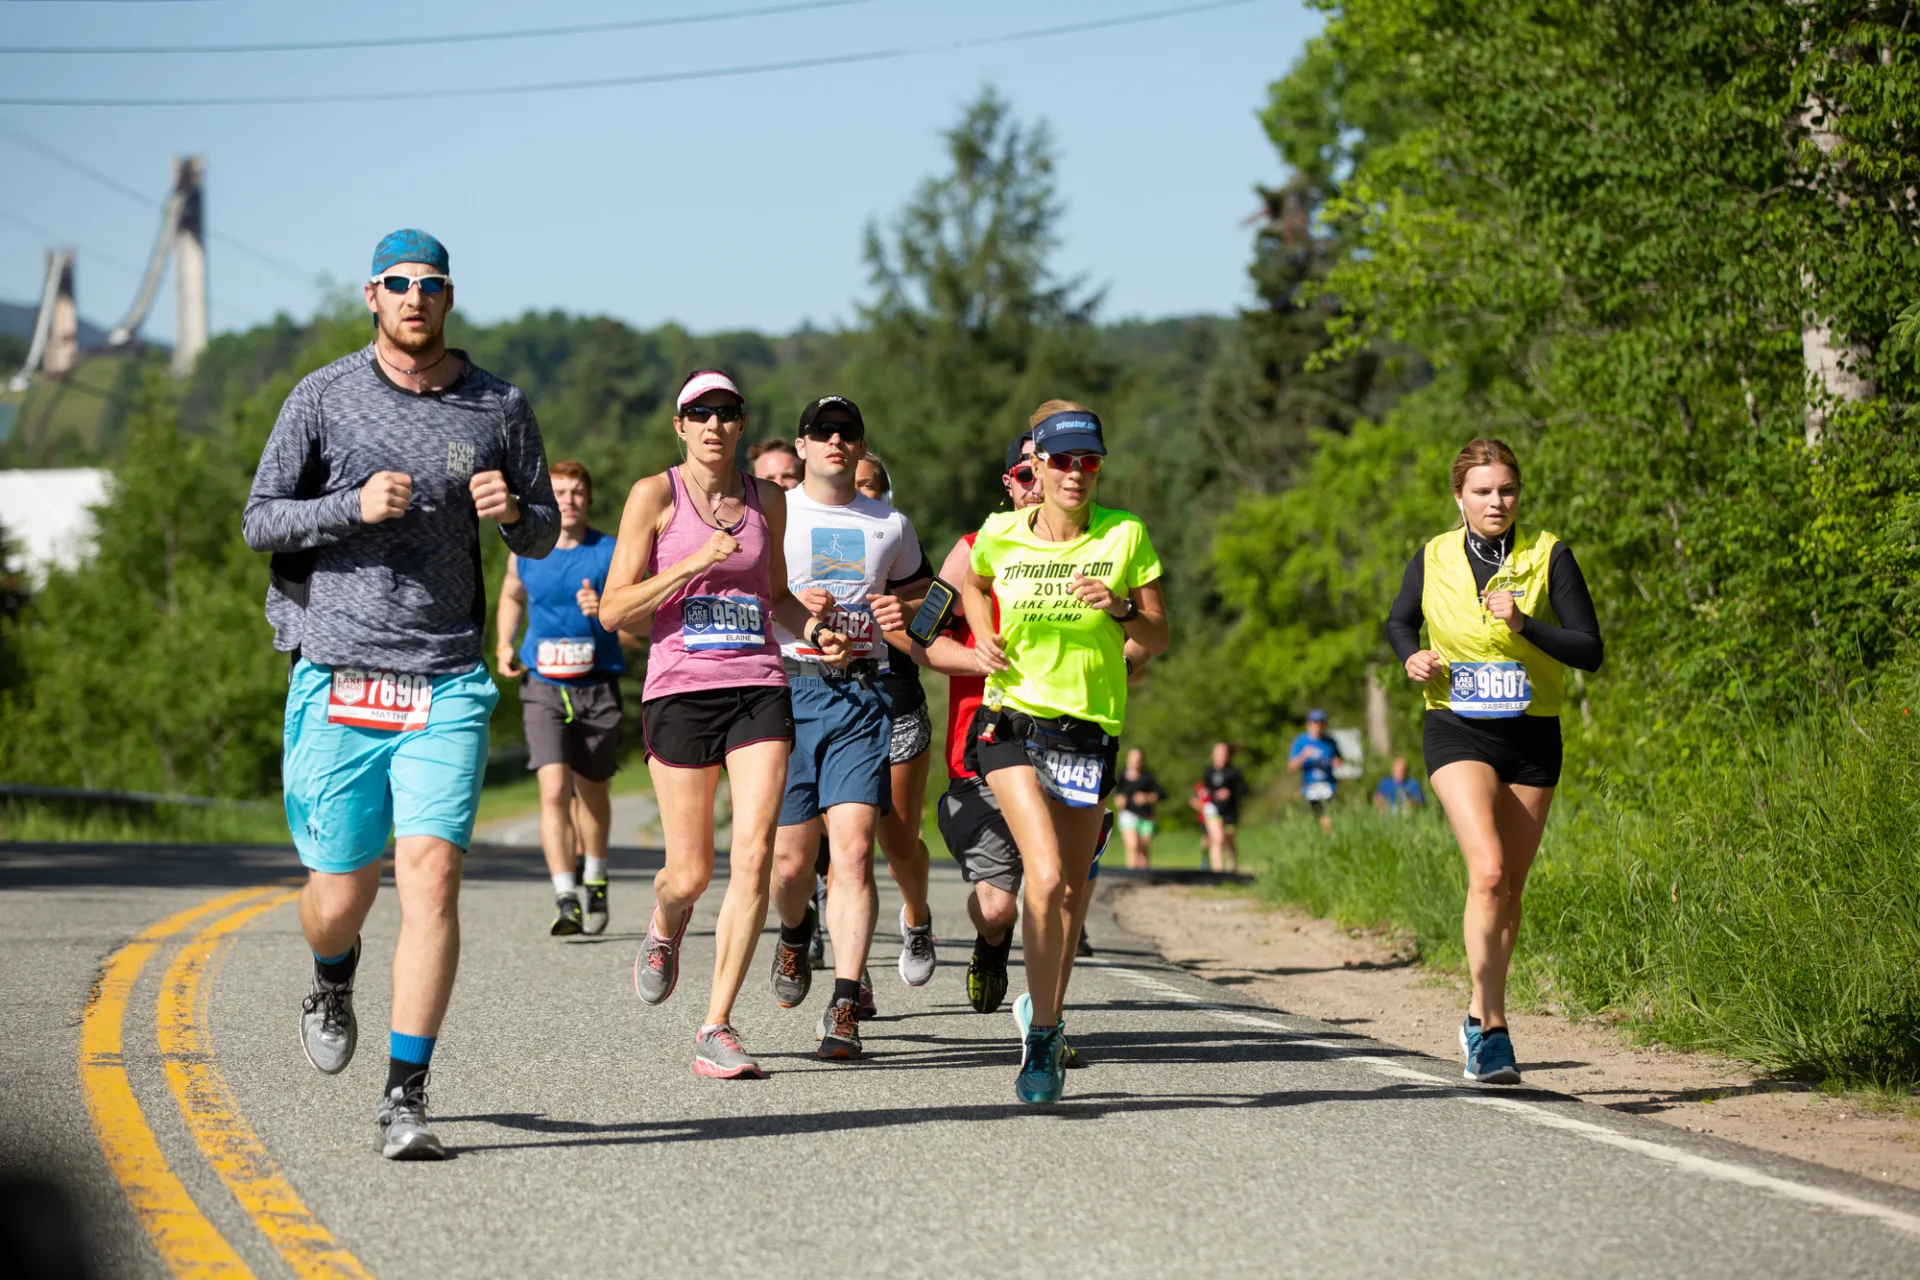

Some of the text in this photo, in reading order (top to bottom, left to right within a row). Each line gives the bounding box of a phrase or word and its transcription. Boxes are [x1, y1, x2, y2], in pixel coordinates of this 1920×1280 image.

[448, 441, 475, 454] RUN
[447, 451, 474, 465] MAG
[447, 461, 474, 474] MILE
[1034, 583, 1075, 596] 2018
[1013, 600, 1045, 610] LAKE
[687, 609, 708, 617] LAKE
[712, 603, 761, 631] 9589
[1023, 613, 1082, 622] TRI-CAMP
[826, 611, 871, 638] 7562
[725, 634, 752, 642] ELAINE
[336, 677, 363, 685] LAKE
[1477, 670, 1526, 698] 9607
[366, 670, 428, 710] 7690
[1482, 702, 1524, 710] GABRIELLE
[1046, 751, 1099, 790] 9843
